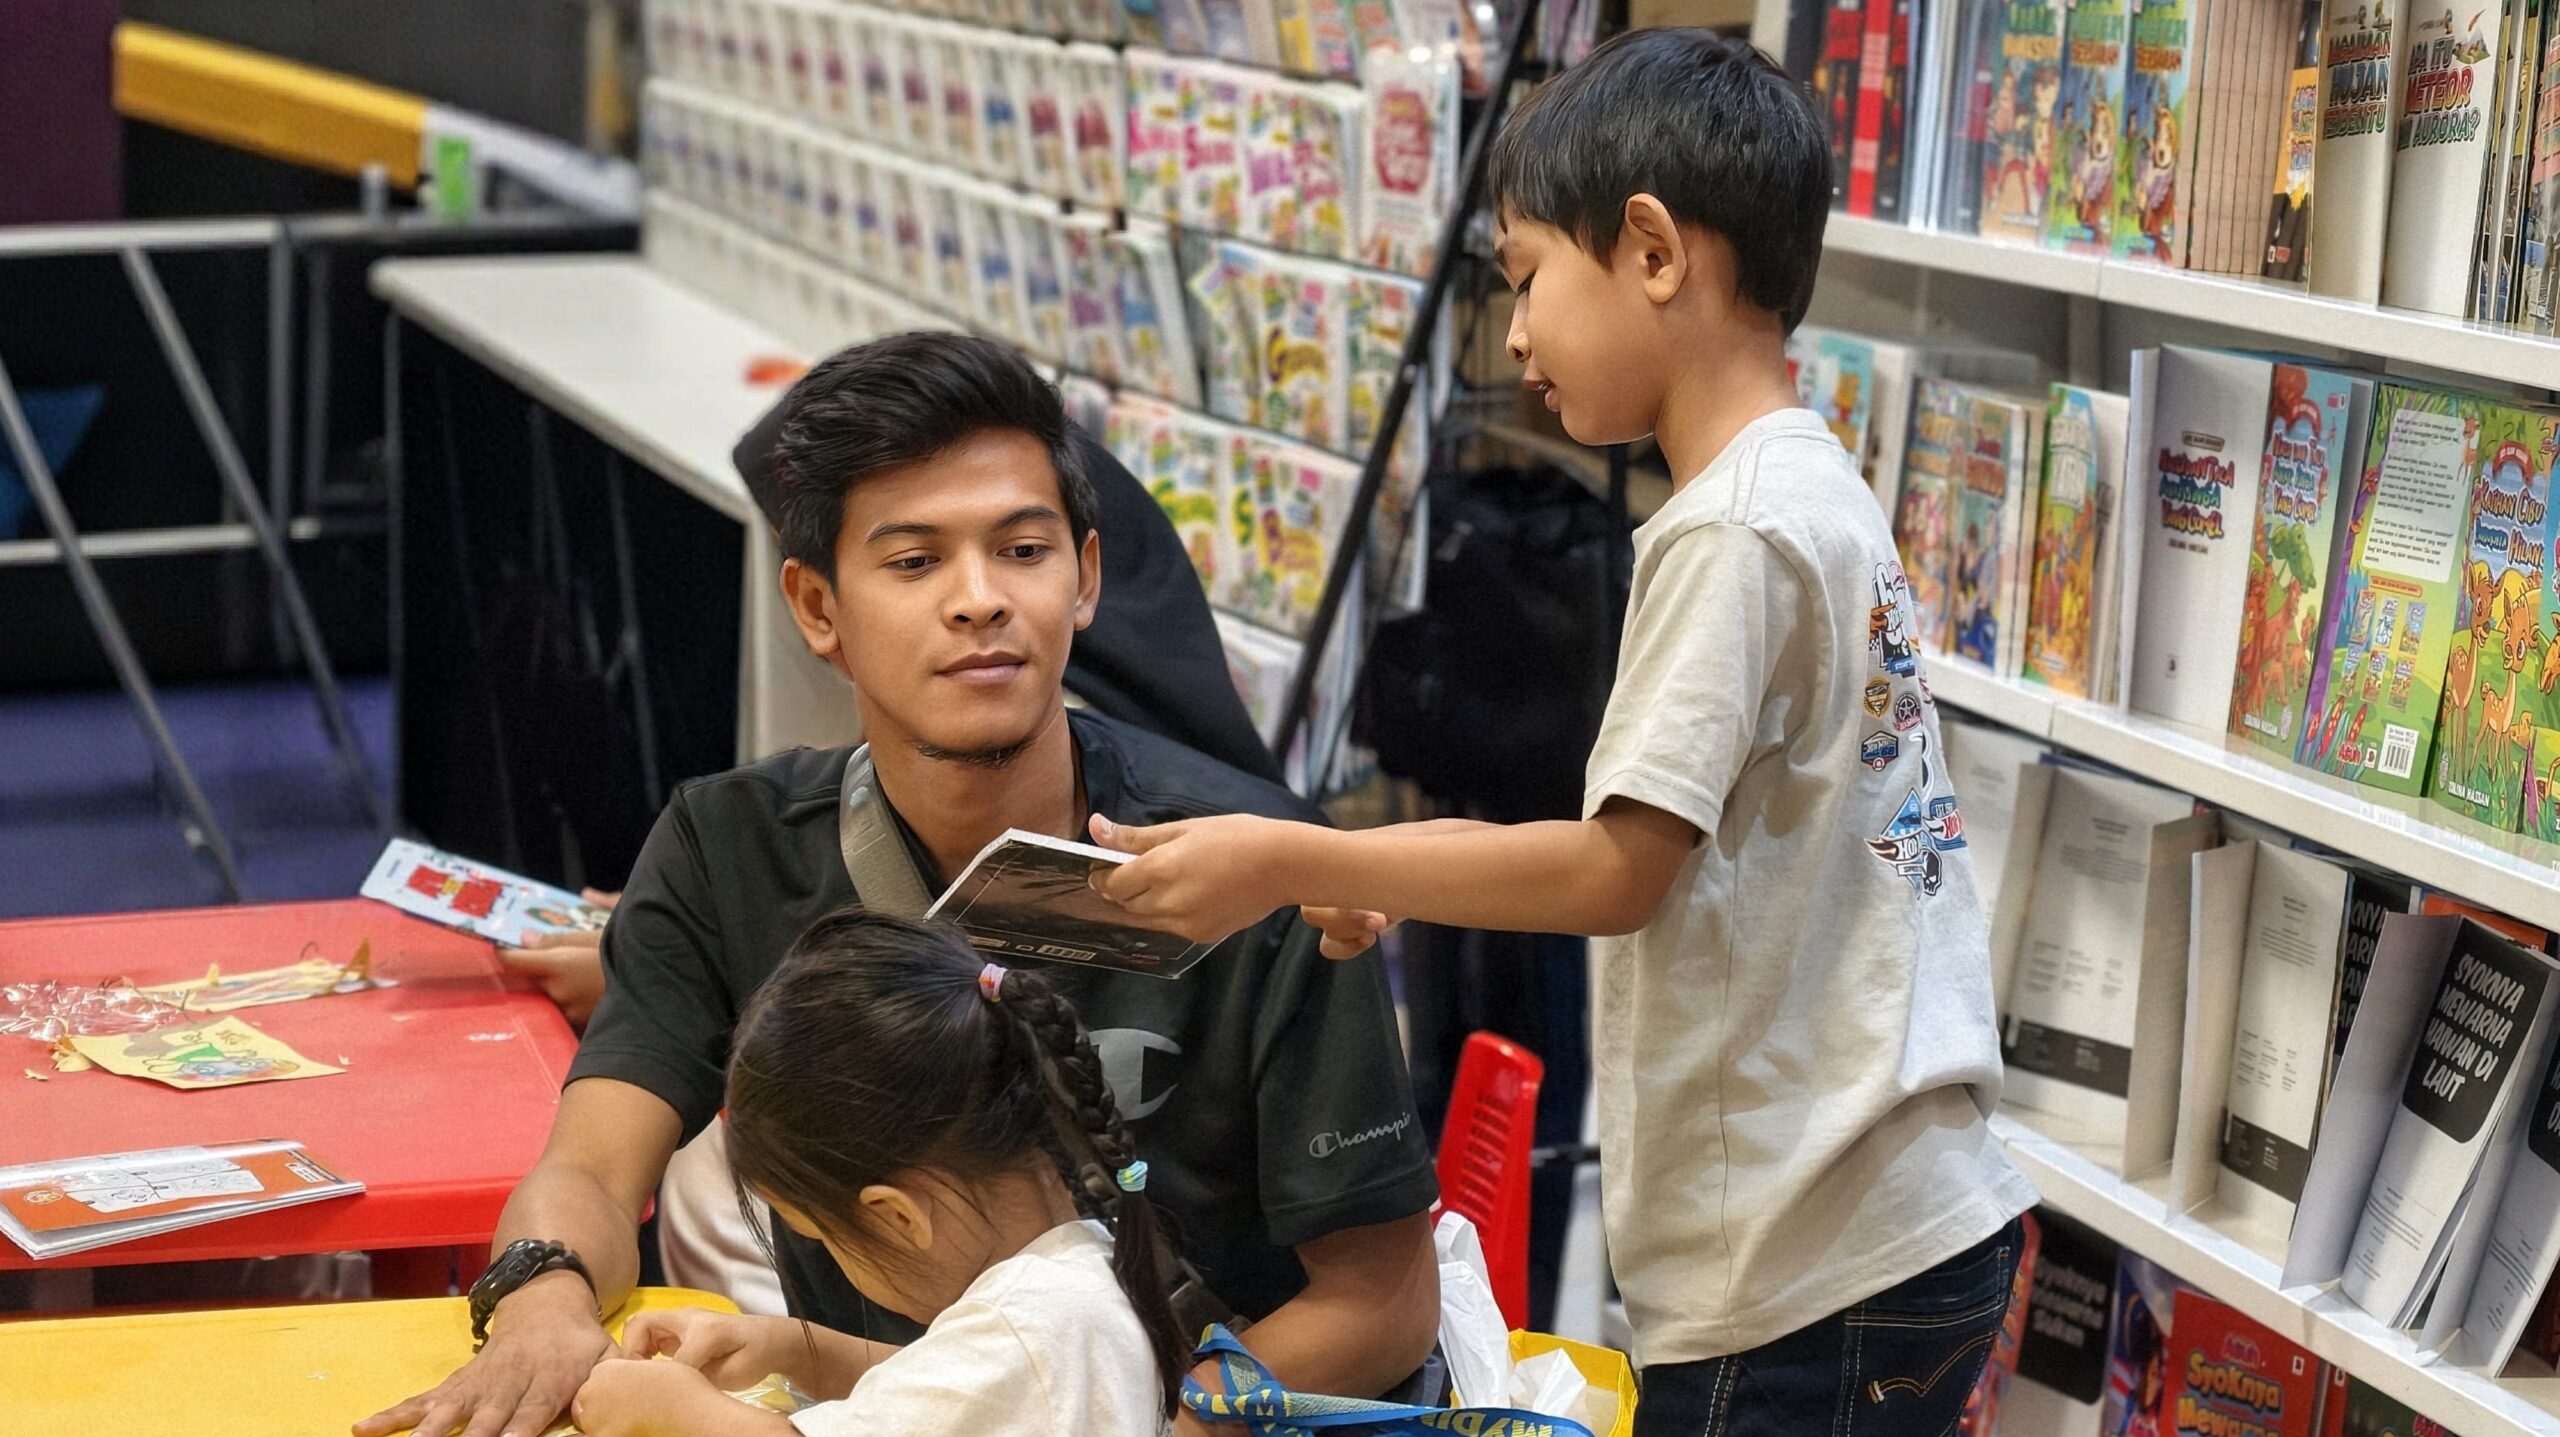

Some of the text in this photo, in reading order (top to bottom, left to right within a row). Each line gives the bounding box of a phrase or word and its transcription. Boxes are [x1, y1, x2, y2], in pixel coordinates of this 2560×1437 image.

[2430, 37, 2455, 70] ITU
[2412, 107, 2480, 148] AURORA?
[2454, 953, 2525, 1014] SYOKNYA
[2436, 984, 2514, 1049] MEWARNA
[2423, 1017, 2499, 1082] HAIWAN DI
[2422, 1059, 2466, 1102] LAUT
[2187, 1352, 2281, 1413] Syoknya
